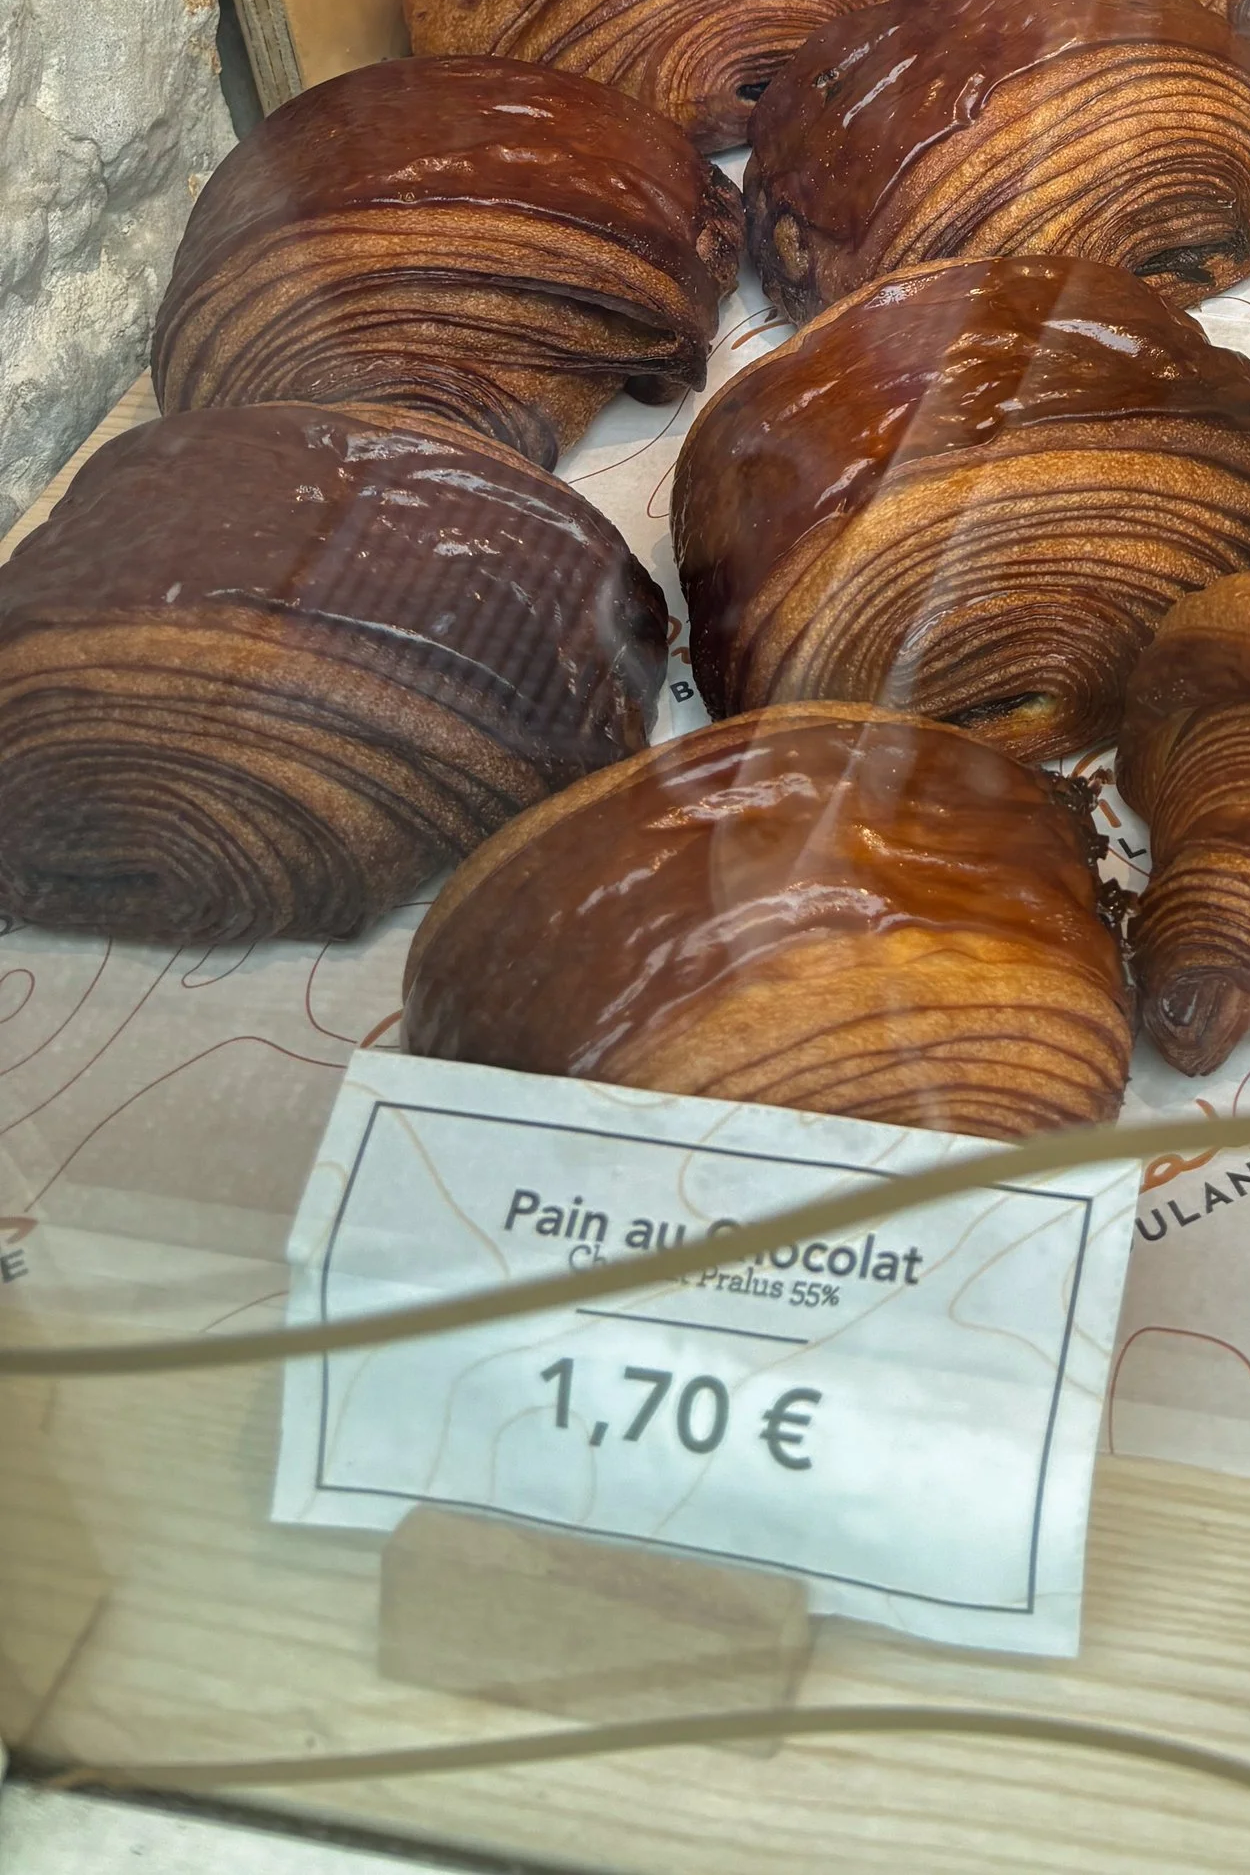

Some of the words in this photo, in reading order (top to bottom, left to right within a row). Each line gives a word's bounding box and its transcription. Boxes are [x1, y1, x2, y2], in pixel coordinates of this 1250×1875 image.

[502, 1187, 609, 1244] Pain
[624, 1216, 687, 1252] au
[698, 1266, 785, 1300] Pralus
[787, 1280, 843, 1309] 55%
[539, 1356, 731, 1454] 1,70
[759, 1385, 824, 1472] €
